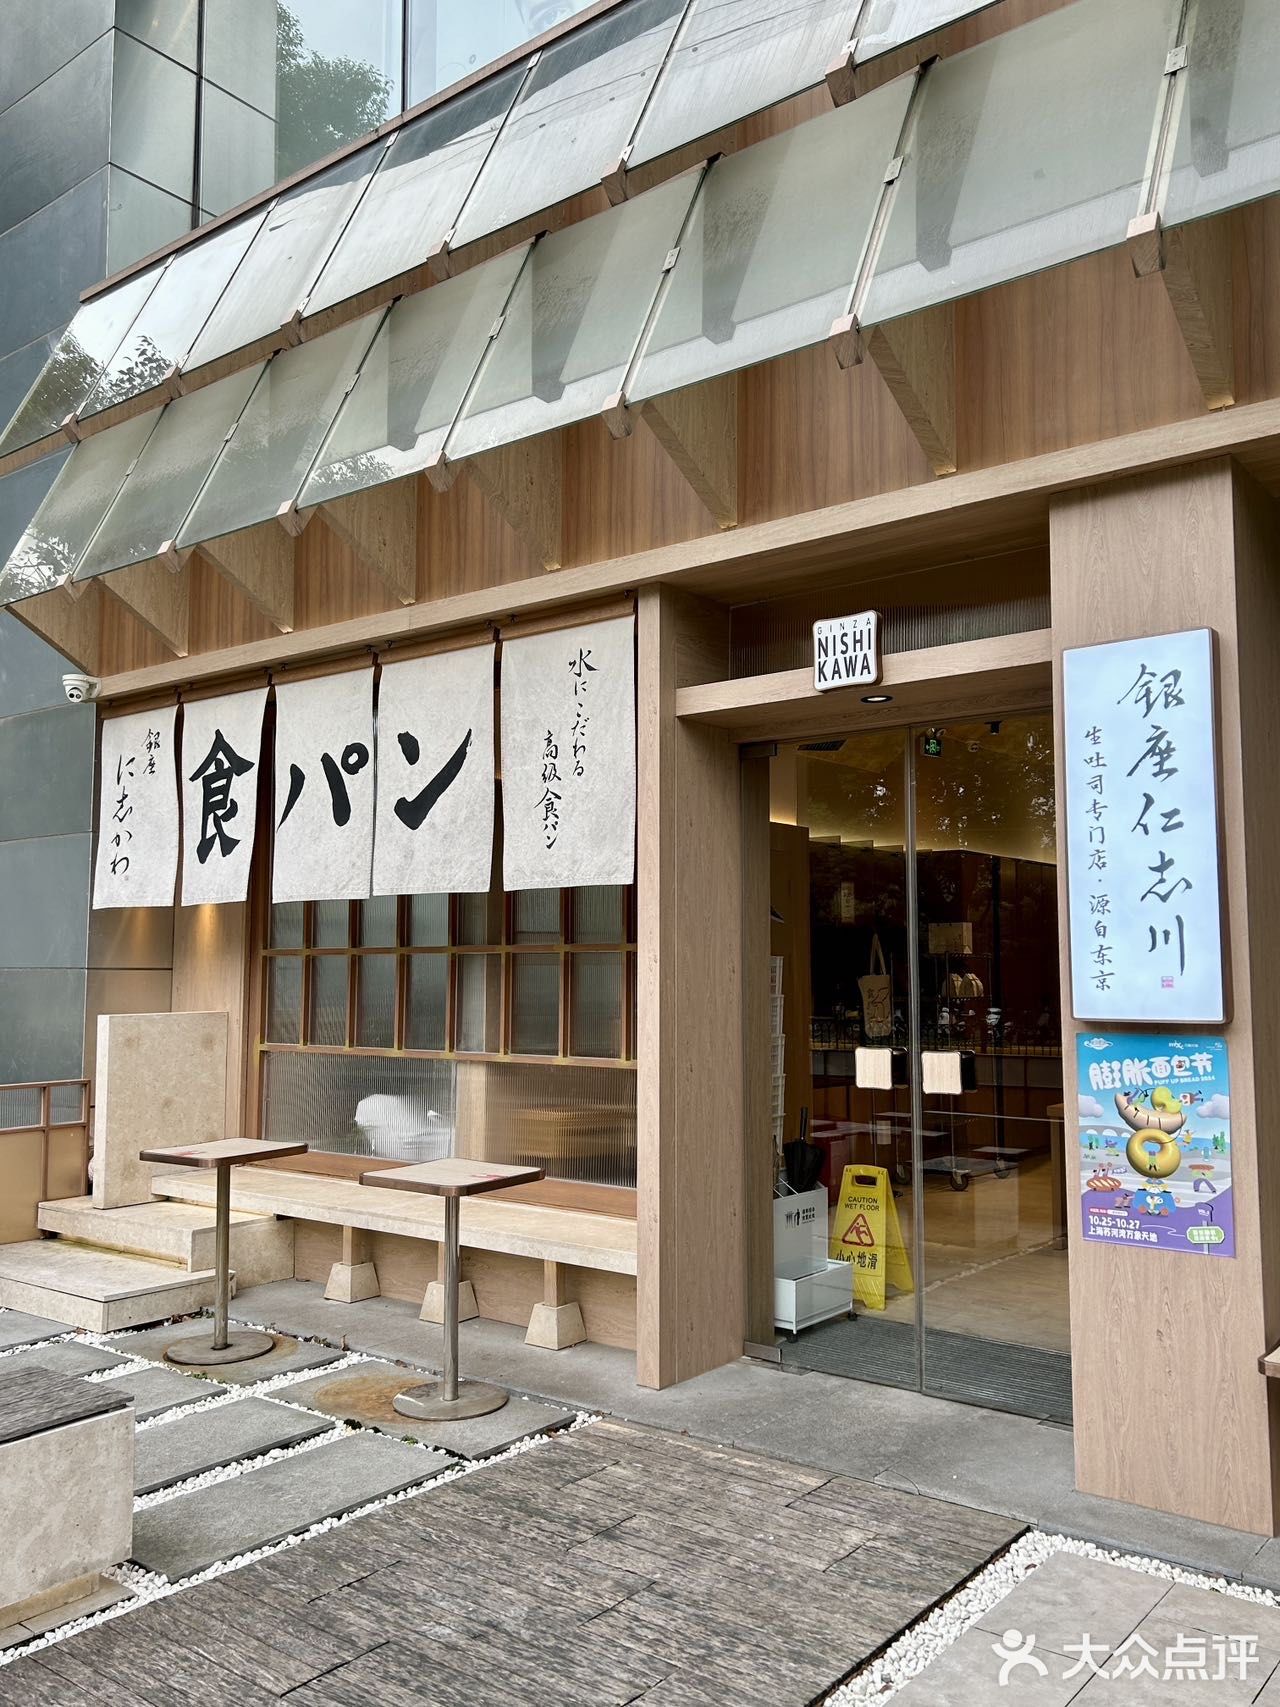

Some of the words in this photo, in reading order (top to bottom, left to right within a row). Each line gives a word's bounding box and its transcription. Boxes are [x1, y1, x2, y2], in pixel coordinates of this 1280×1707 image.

[817, 617, 872, 635] GINZA
[817, 627, 872, 660] NISHI
[818, 652, 872, 683] KAWA
[568, 647, 600, 777] 水にこだわる
[141, 728, 161, 776] 銀座
[534, 729, 562, 850] 高級食パン
[1116, 663, 1193, 977] 銀座仁志川
[1088, 1052, 1213, 1091] 膨胀面包节
[847, 1196, 878, 1204] CAUTION
[1088, 1215, 1140, 1230] 10.25-10.27
